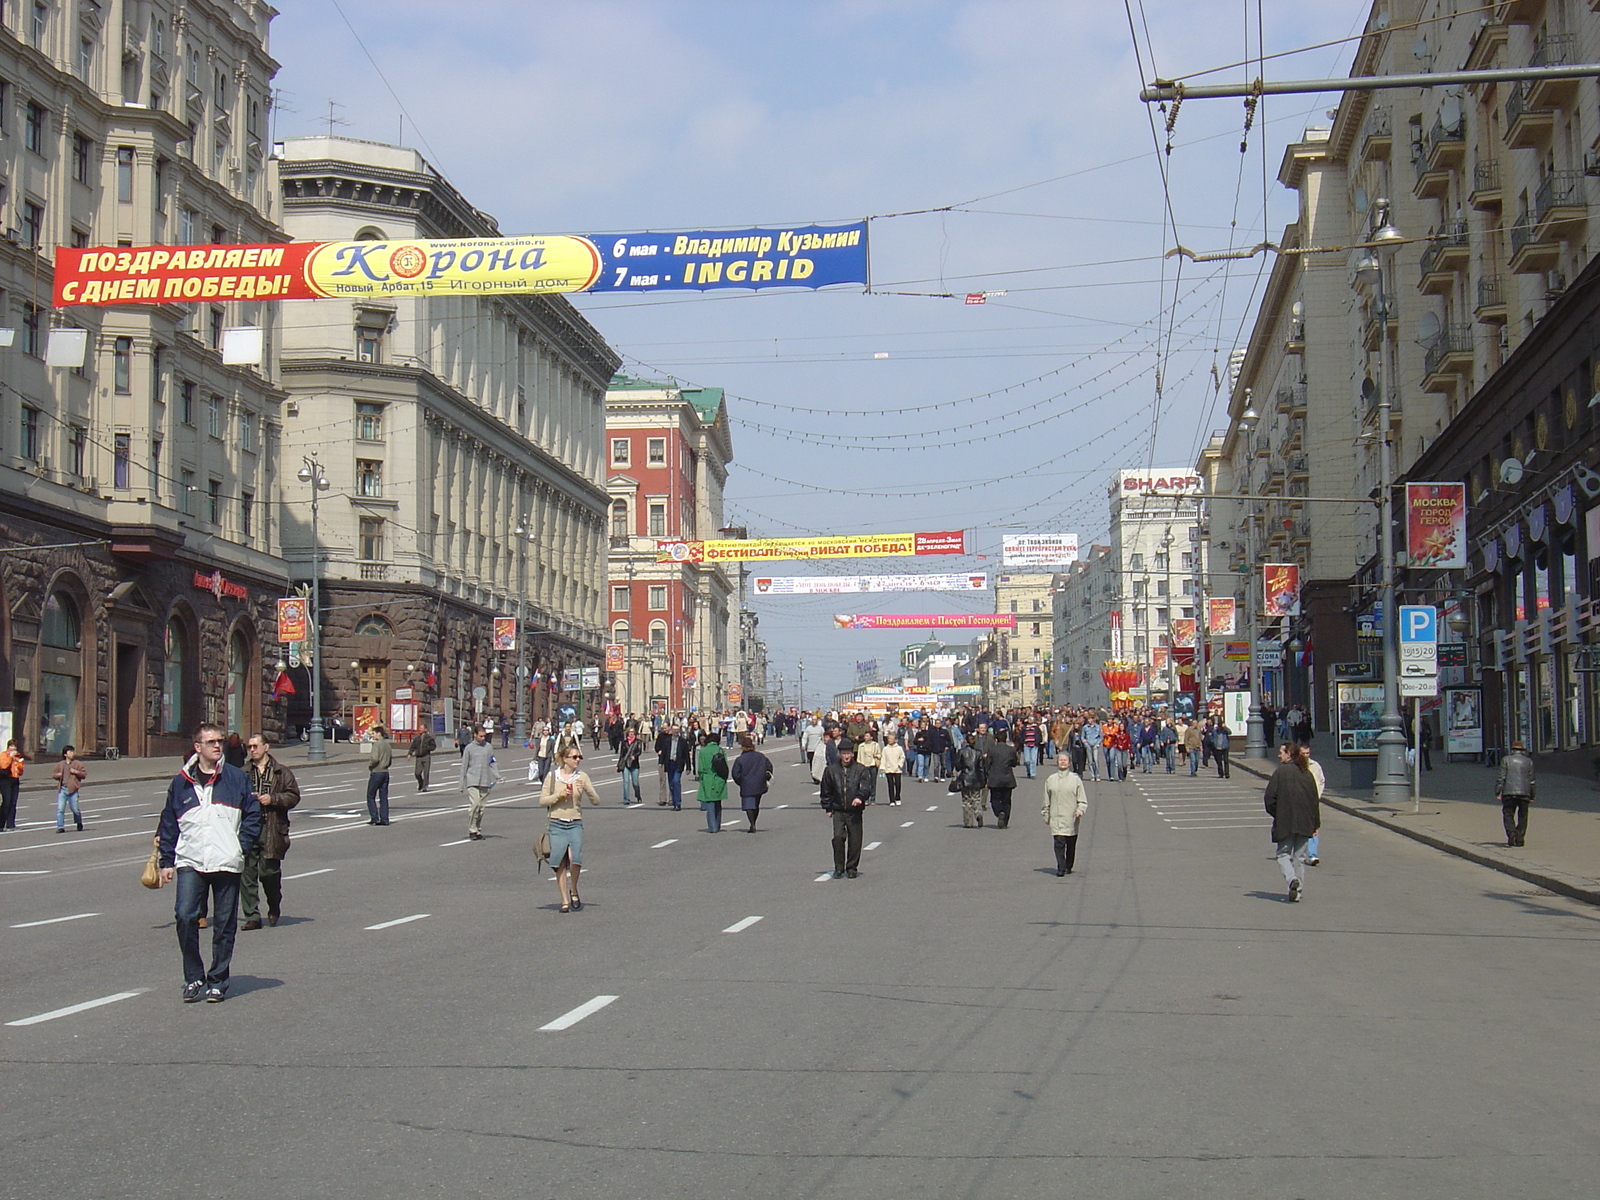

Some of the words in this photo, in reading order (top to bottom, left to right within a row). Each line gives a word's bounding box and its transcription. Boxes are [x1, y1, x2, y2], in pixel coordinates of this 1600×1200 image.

[430, 238, 545, 248] www.korona-casino.ru
[612, 238, 628, 258] 6
[629, 245, 658, 256] мая
[673, 235, 772, 258] Владимир
[776, 230, 861, 256] Кузьмин
[78, 248, 285, 275] ПОЗДРАВЛЯЕМ
[613, 267, 628, 287] 7
[629, 275, 659, 286] мая
[683, 258, 815, 284] INGRID
[62, 281, 79, 301] С
[80, 278, 161, 303] ДНЕМ
[163, 274, 292, 298] ПОБЕДЫ!
[336, 283, 374, 293] Новый
[450, 278, 527, 291] Игорный
[534, 279, 569, 289] дом
[1123, 476, 1200, 490] SHARP
[1413, 498, 1458, 507] МОСКВА
[1420, 508, 1452, 517] ГОРОД
[1420, 516, 1452, 525] ГЕРОЙ
[707, 547, 782, 559] ФЕСТИВАЛЬ
[810, 545, 850, 556] ВИВАТ
[854, 543, 913, 554] ПОБЕДА!
[875, 617, 931, 626] Поздравляем
[937, 616, 966, 626] Пасхой
[968, 615, 1012, 626] Господней!
[1410, 611, 1430, 639] P
[1340, 685, 1362, 702] 60
